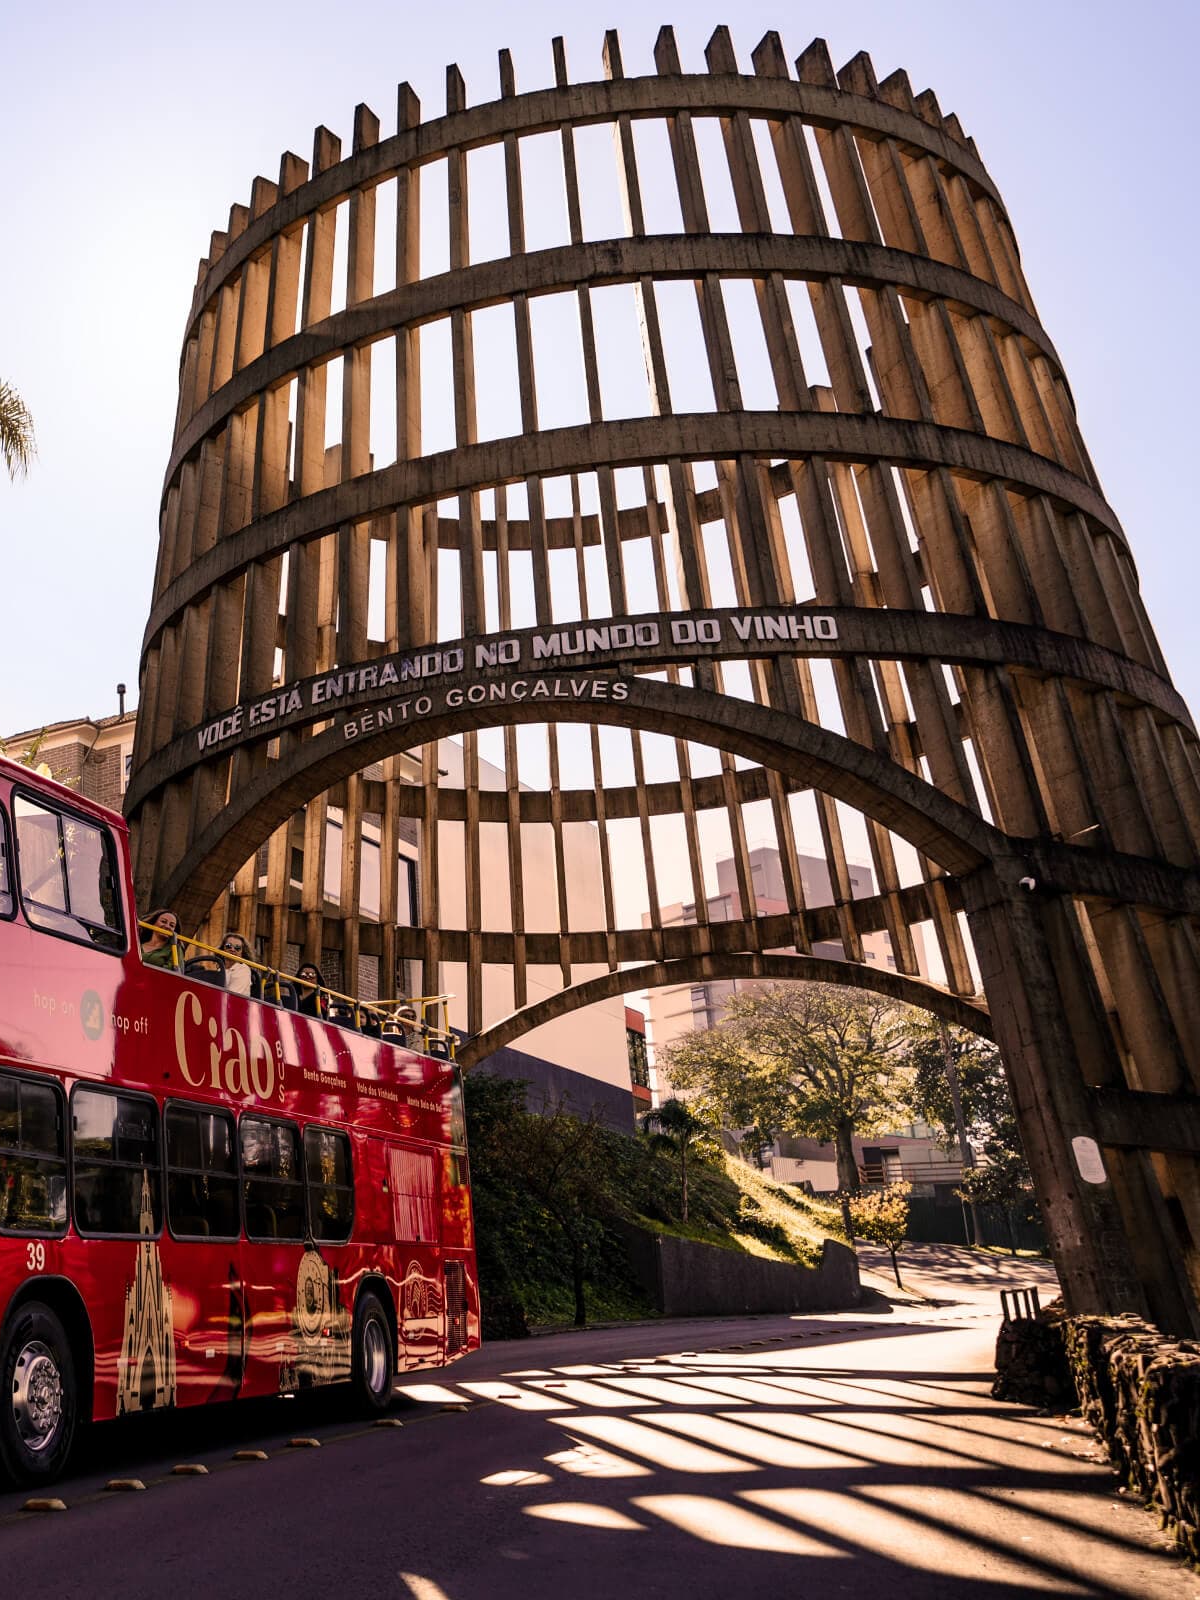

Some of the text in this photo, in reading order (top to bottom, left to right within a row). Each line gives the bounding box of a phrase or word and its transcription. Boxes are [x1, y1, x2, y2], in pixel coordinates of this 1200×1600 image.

[197, 615, 839, 751] VOCÊ ESTÁ ENTRANDO NO MUNDO DO VINHO
[343, 679, 629, 740] BENTO GONÇALVES
[33, 992, 75, 1016] hop on
[133, 1016, 148, 1035] off
[174, 990, 275, 1100] Ciao
[275, 1040, 286, 1103] BUS
[303, 1068, 347, 1089] Bento Gonçalves
[26, 1242, 45, 1270] 39
